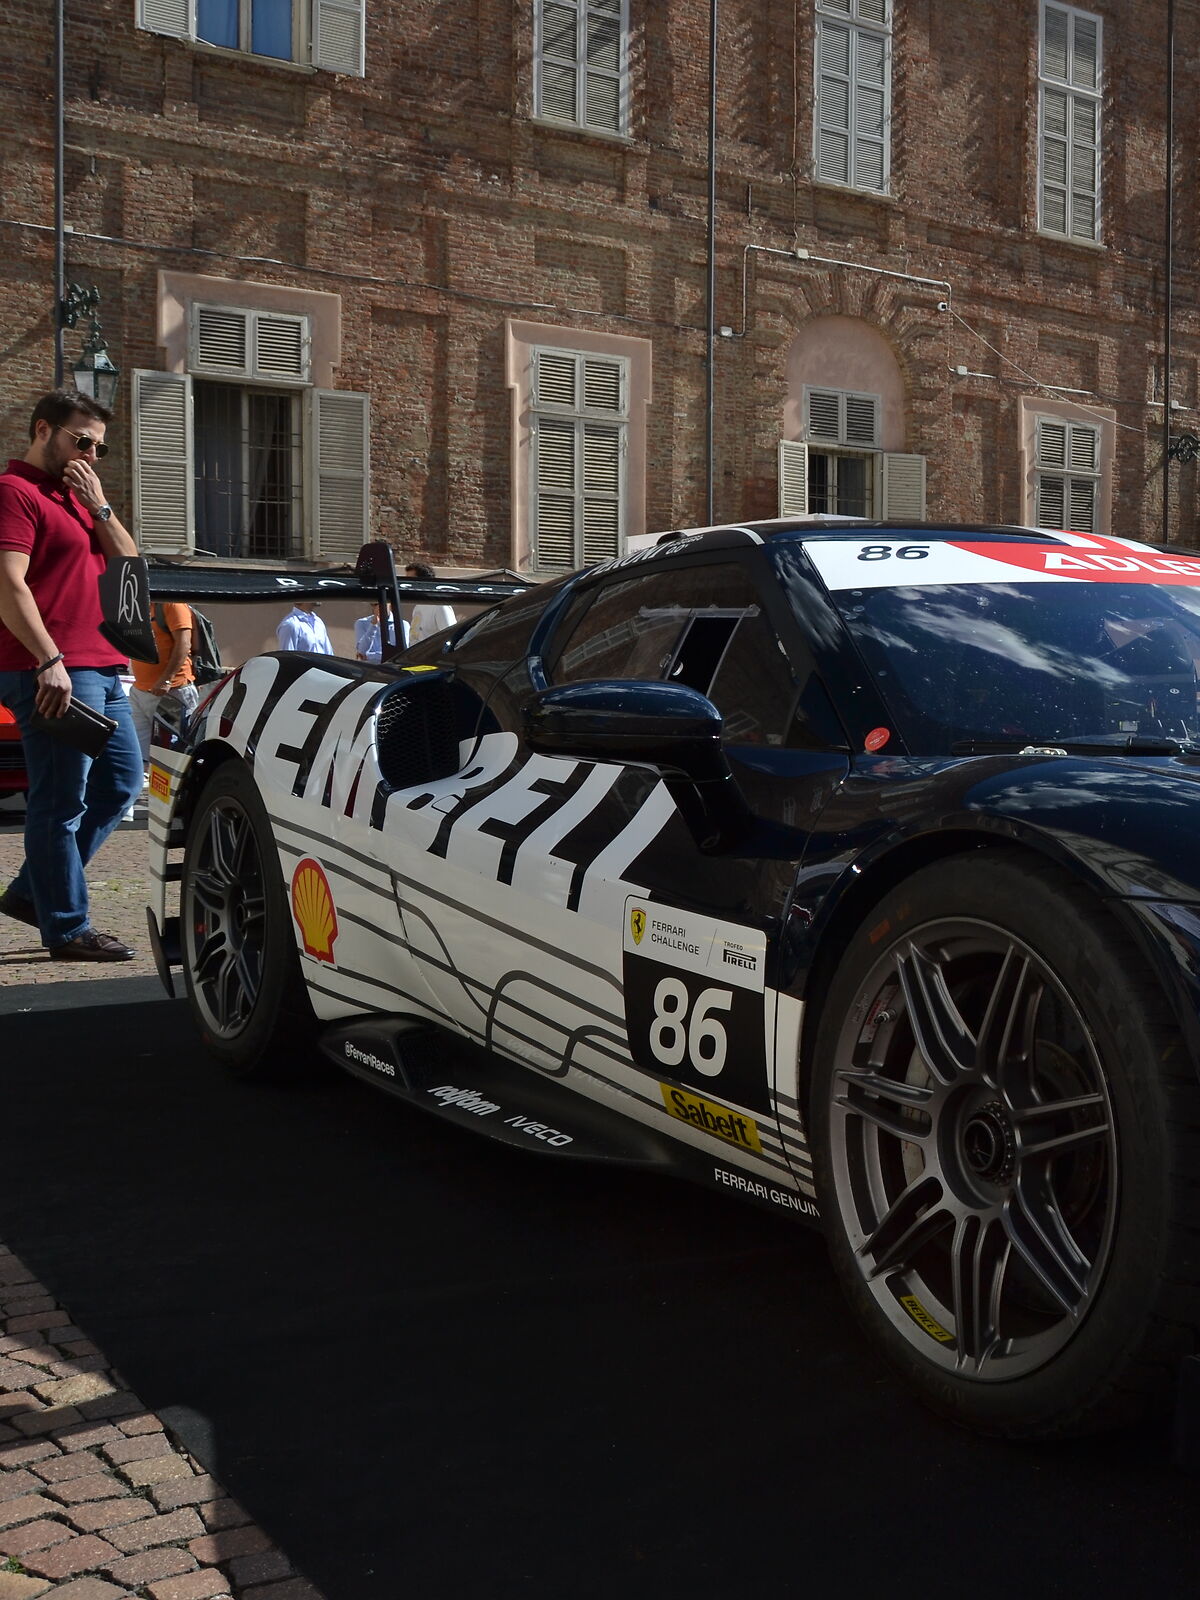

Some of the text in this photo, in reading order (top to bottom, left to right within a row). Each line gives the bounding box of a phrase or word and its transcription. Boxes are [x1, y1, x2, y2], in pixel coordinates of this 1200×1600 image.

[857, 544, 930, 562] 86
[652, 920, 686, 938] FERRARI
[651, 933, 700, 955] CHALLENGE
[724, 940, 744, 951] TROFEO
[723, 948, 757, 971] PIRELLI
[650, 977, 733, 1077] 86
[344, 1041, 396, 1077] @FerrariRaces
[504, 1115, 574, 1147] IVECO
[670, 1089, 752, 1146] Sabelt
[714, 1168, 768, 1200] FERRARI
